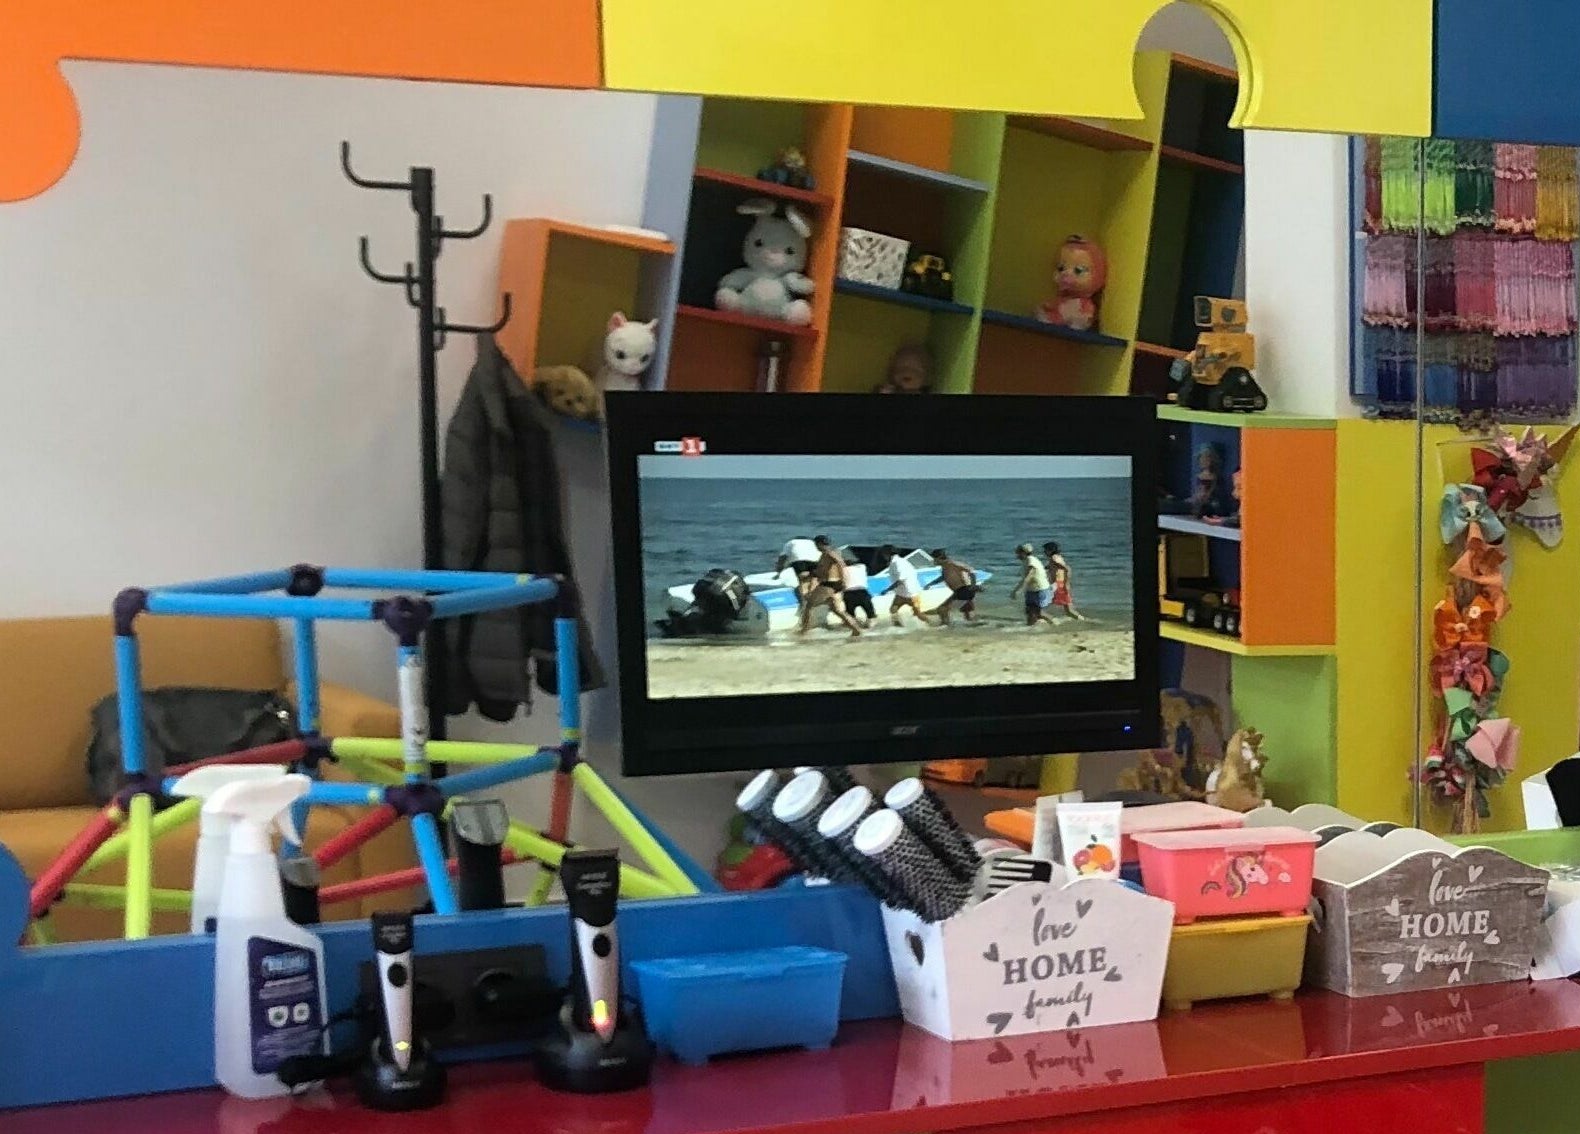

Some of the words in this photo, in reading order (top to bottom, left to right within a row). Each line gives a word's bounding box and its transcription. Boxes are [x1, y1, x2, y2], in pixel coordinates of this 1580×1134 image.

[1428, 869, 1467, 906] love
[1032, 907, 1078, 946] love
[1400, 909, 1490, 939] HOME
[1002, 946, 1107, 985] HOME
[1414, 940, 1474, 975] family
[1022, 981, 1093, 1019] family
